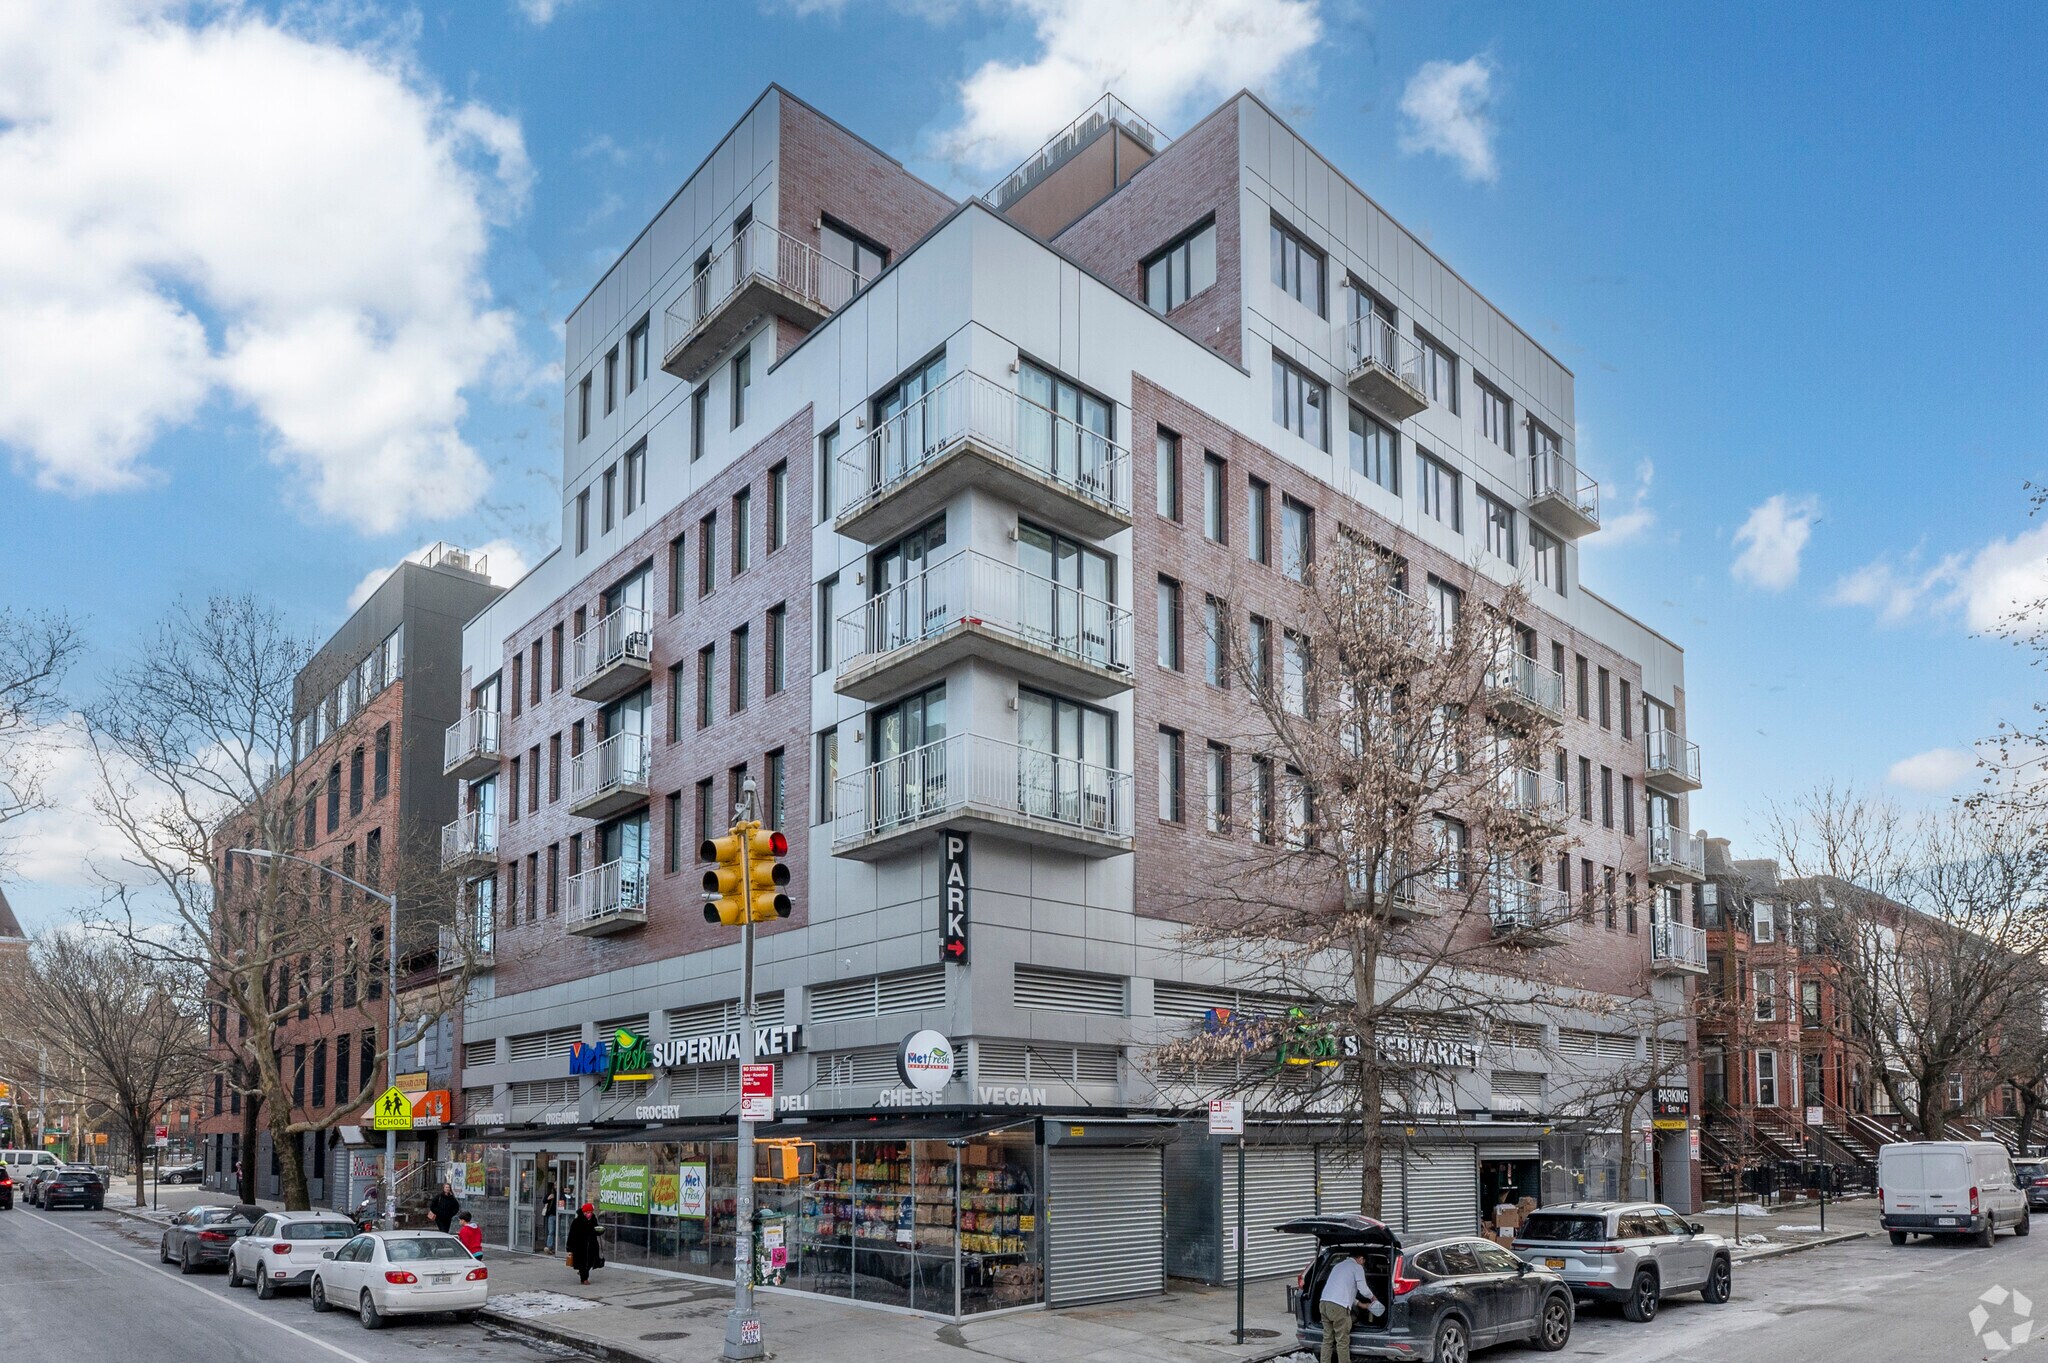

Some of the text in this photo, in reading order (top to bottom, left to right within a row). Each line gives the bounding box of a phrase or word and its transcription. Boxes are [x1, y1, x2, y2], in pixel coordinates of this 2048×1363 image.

[947, 836, 965, 937] PARK
[569, 1024, 797, 1093] Met fresh SUPERMAKET
[1344, 1034, 1482, 1067] SPERMARKET
[907, 1049, 950, 1071] Met fresh
[780, 1094, 809, 1112] DELI
[879, 1086, 1047, 1108] CHEESE VEGAN
[1658, 1089, 1689, 1103] PARKING
[474, 1110, 580, 1126] PRODUCE ORGANIC
[636, 1105, 680, 1119] GROCERY
[377, 1117, 409, 1126] SCHOOL
[685, 1174, 701, 1187] Met
[600, 1189, 646, 1209] SUPERMARKET!
[684, 1187, 700, 1202] fresh
